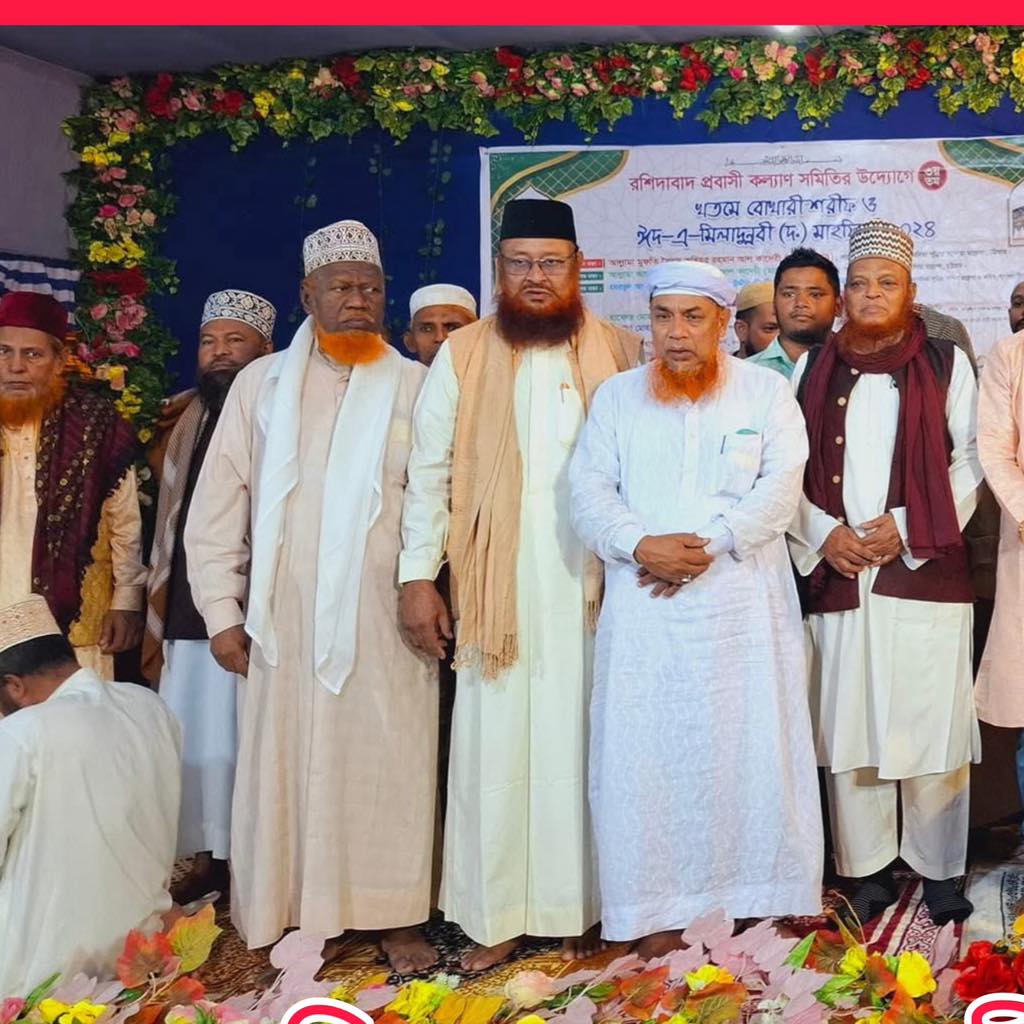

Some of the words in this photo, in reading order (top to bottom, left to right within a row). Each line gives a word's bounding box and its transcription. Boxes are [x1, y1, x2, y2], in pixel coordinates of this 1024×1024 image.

[629, 173, 696, 192] রশিদাবাদ
[701, 170, 742, 190] প্রবাসী
[749, 173, 793, 189] কল্যাণ
[799, 168, 851, 187] সমিতির
[856, 168, 914, 184] উদ্যোগে
[813, 219, 856, 240] মাহফি
[900, 221, 936, 238] ০২৪
